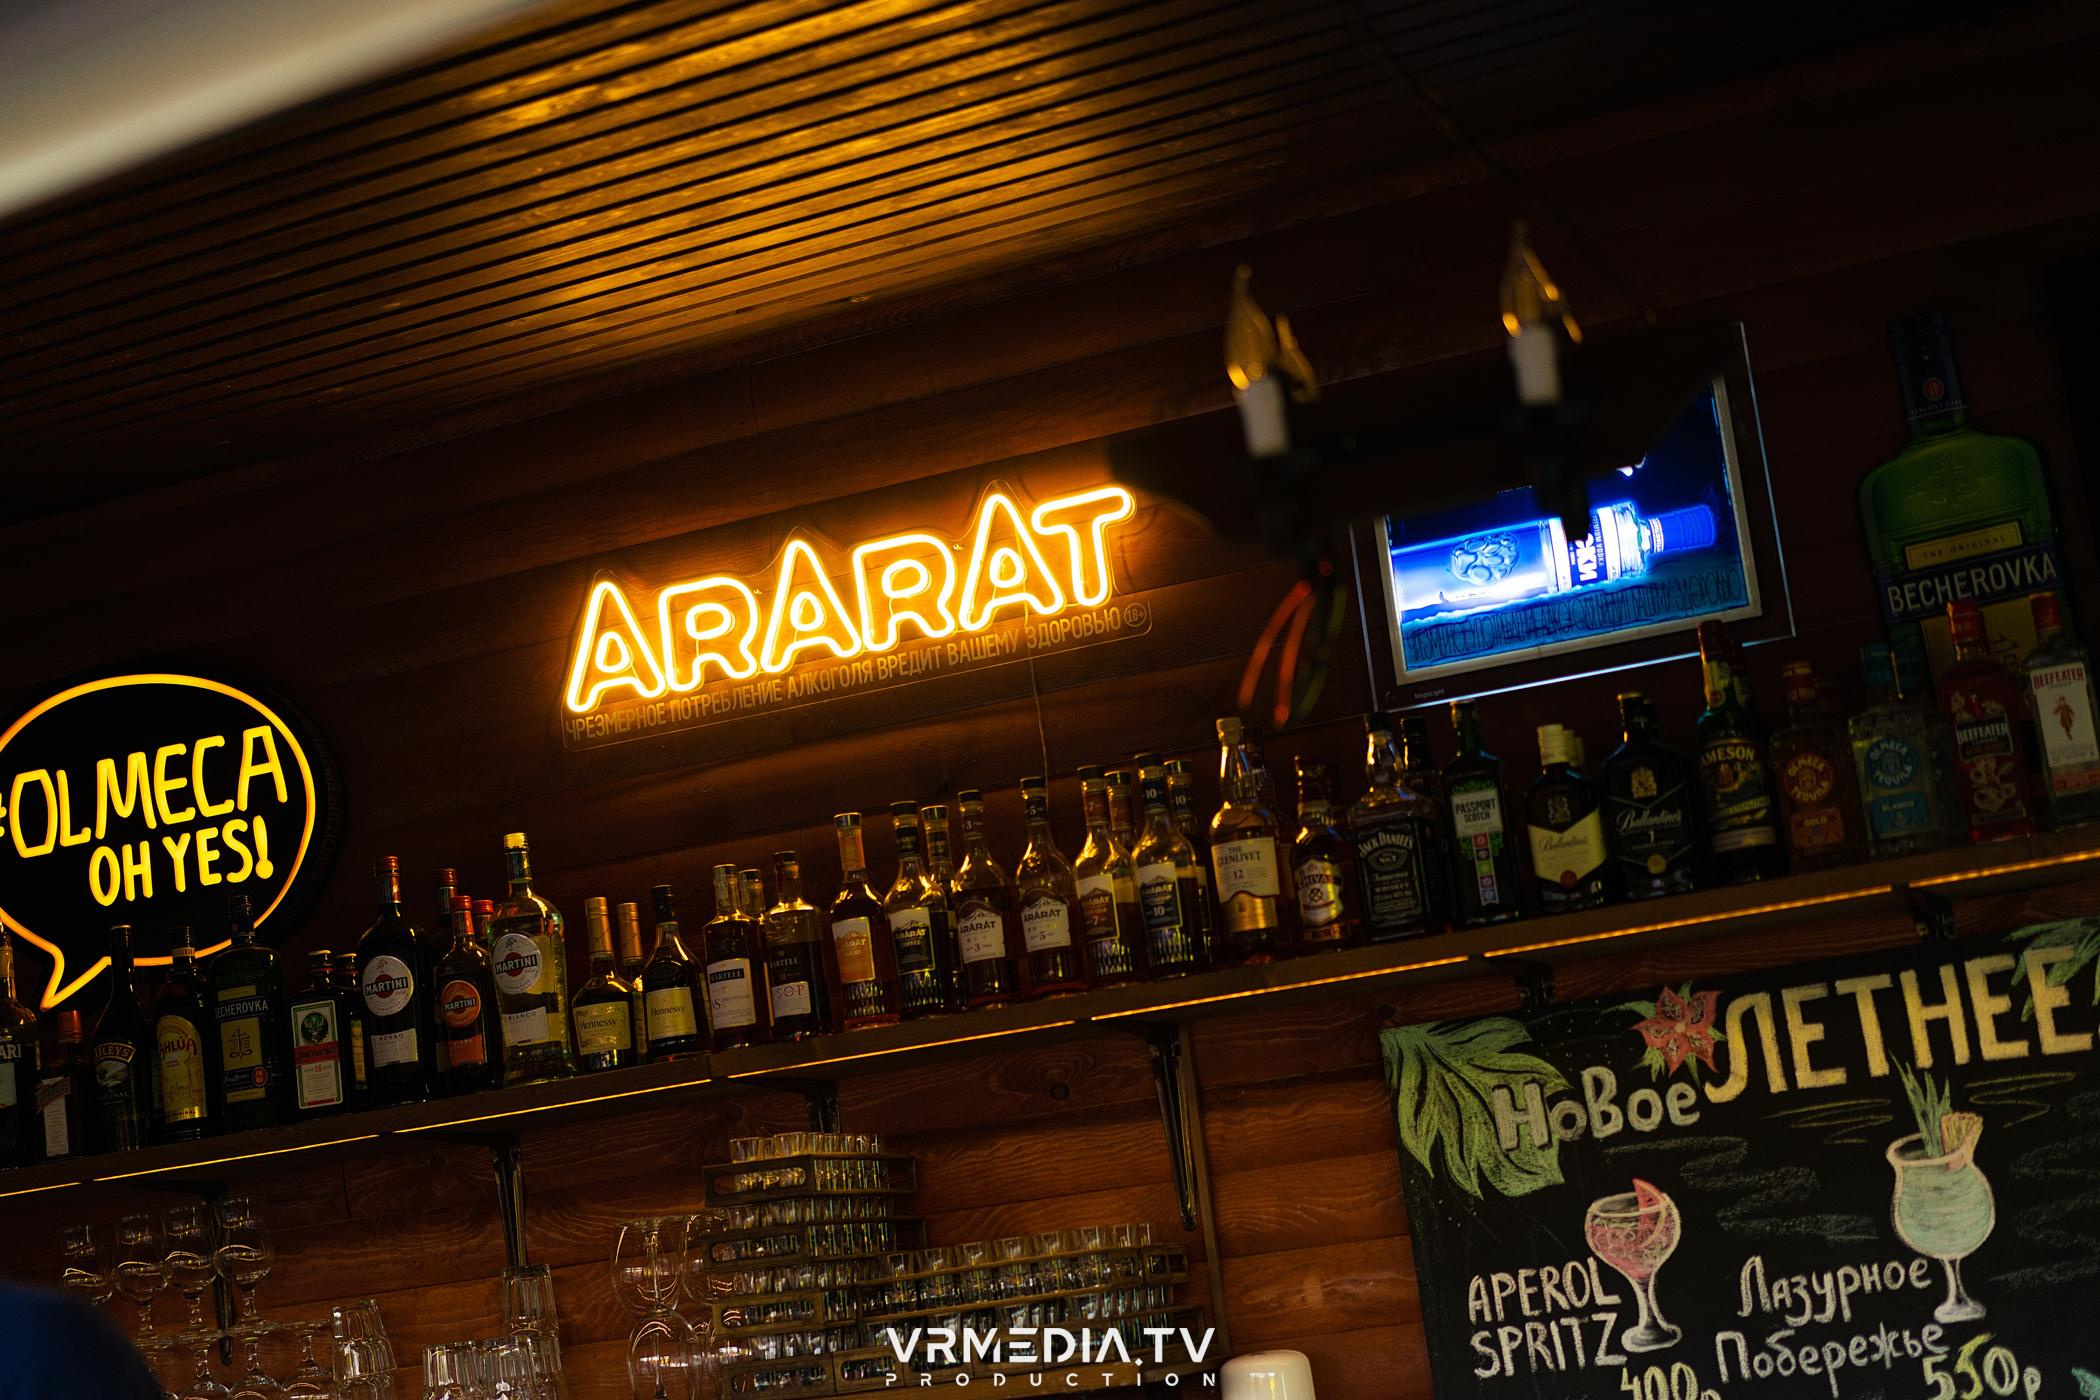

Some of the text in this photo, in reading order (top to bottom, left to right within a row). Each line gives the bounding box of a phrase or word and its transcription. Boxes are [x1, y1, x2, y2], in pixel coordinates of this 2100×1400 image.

[1888, 551, 2057, 614] BECHEROVKA
[566, 485, 1136, 713] ARARAT
[566, 702, 666, 740] ЧРЕЗМЕРНОЕ
[670, 679, 782, 722] ПОТРЕБЛЕНИЕ
[787, 659, 873, 699] АЛКОГОЛЯ
[877, 645, 941, 681] ВРЕДИТ
[946, 629, 1018, 665] ВАШЕМУ
[1026, 607, 1121, 649] ЗДОРОВЬЮ
[2033, 667, 2084, 689] BEEFEATER
[1956, 722, 2009, 745] BEEFEATER
[0, 725, 288, 859] OLMECA
[1145, 787, 1157, 799] 10
[1455, 799, 1496, 815] PASSPORT
[1464, 811, 1491, 823] SCOTCH
[89, 840, 153, 906] OH
[162, 814, 274, 893] YES!
[1217, 851, 1260, 867] GLENLIVET
[1233, 869, 1244, 879] 12
[1153, 906, 1165, 917] 10
[974, 943, 981, 952] 3
[495, 954, 537, 974] MARTINI
[365, 977, 408, 996] MARTINI
[444, 998, 476, 1012] MARTINI
[651, 1005, 685, 1017] Hennessy
[508, 1011, 537, 1021] BIANCO
[580, 1018, 616, 1031] Hennessy
[1704, 945, 2095, 1104] ЛЕТНЕЕ
[1468, 1256, 1622, 1325] APEROL
[1736, 1254, 1933, 1327] Лазурное
[1469, 1311, 1628, 1380] SPRITZ
[1715, 1320, 1950, 1400] Побережье
